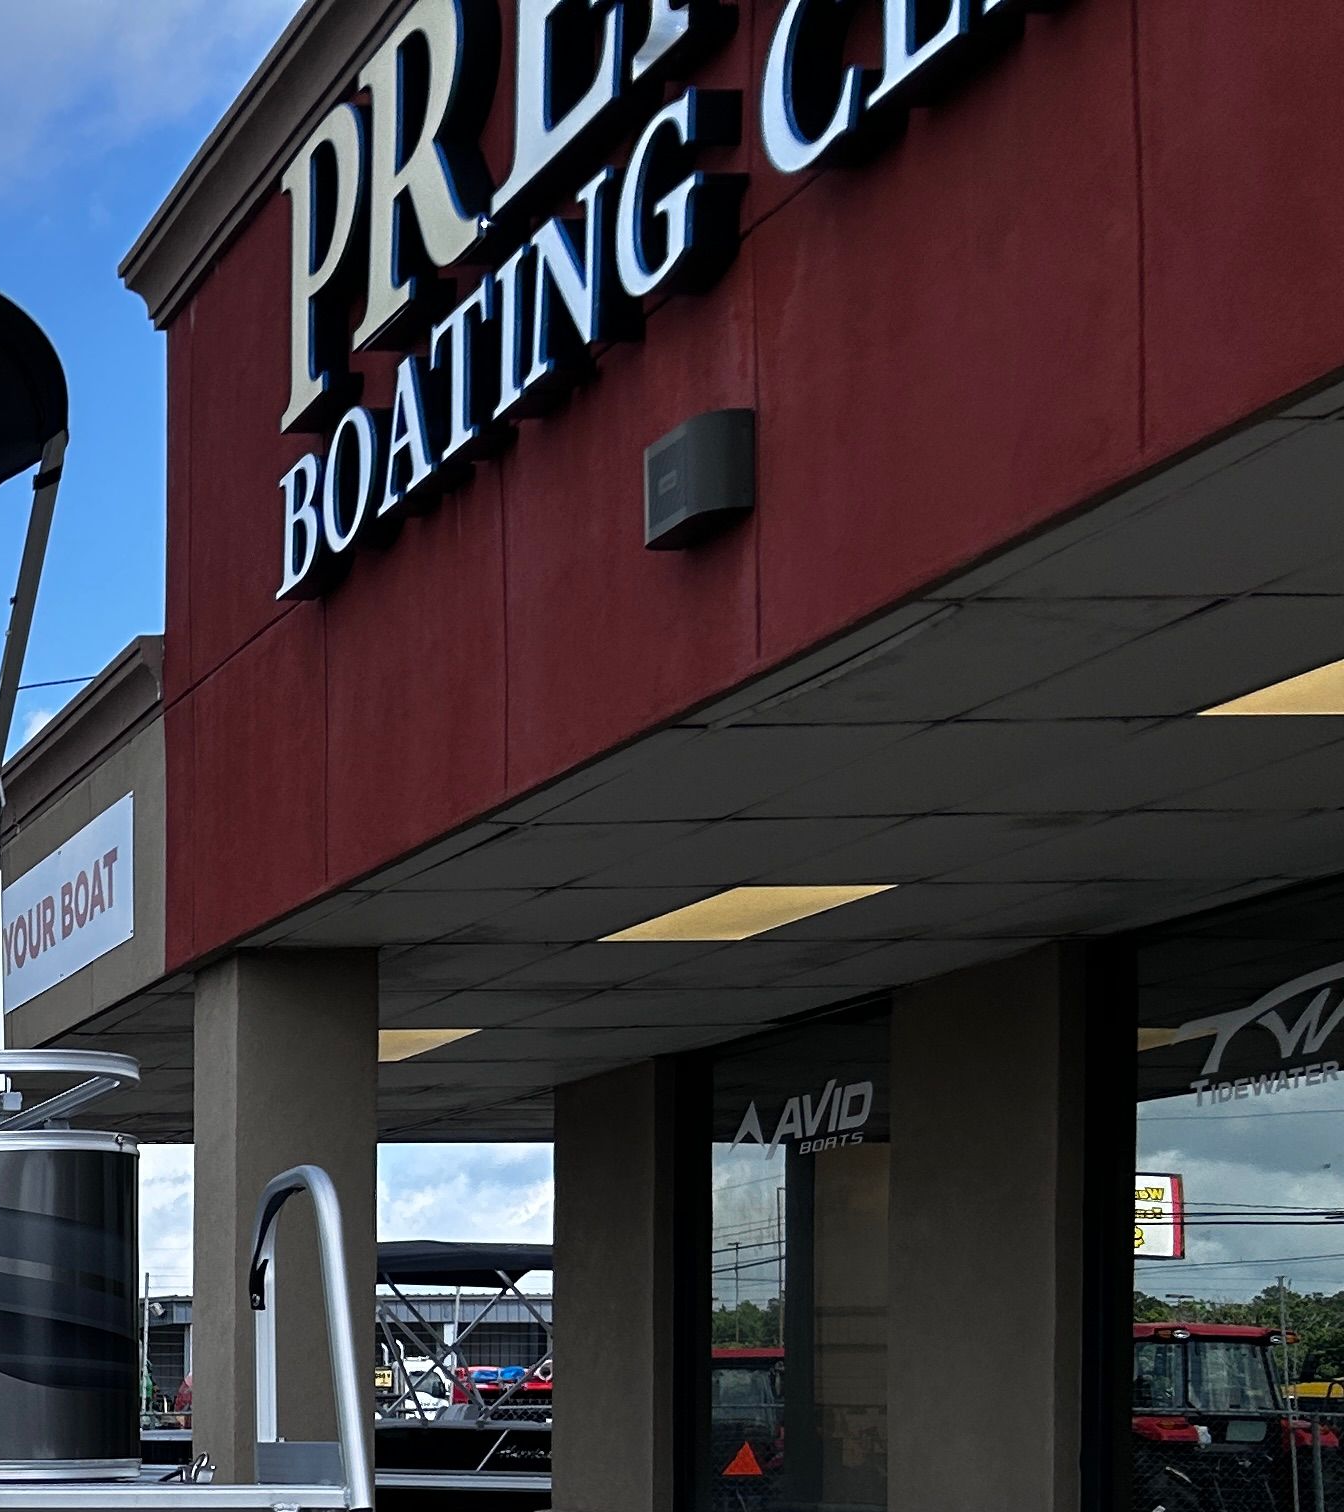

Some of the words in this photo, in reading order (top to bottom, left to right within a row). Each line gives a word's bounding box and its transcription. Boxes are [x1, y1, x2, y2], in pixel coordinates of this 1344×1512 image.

[276, 85, 705, 600] BOATING
[3, 895, 55, 977] YOUR
[61, 846, 119, 941] BOAT
[799, 1131, 865, 1156] BOATS
